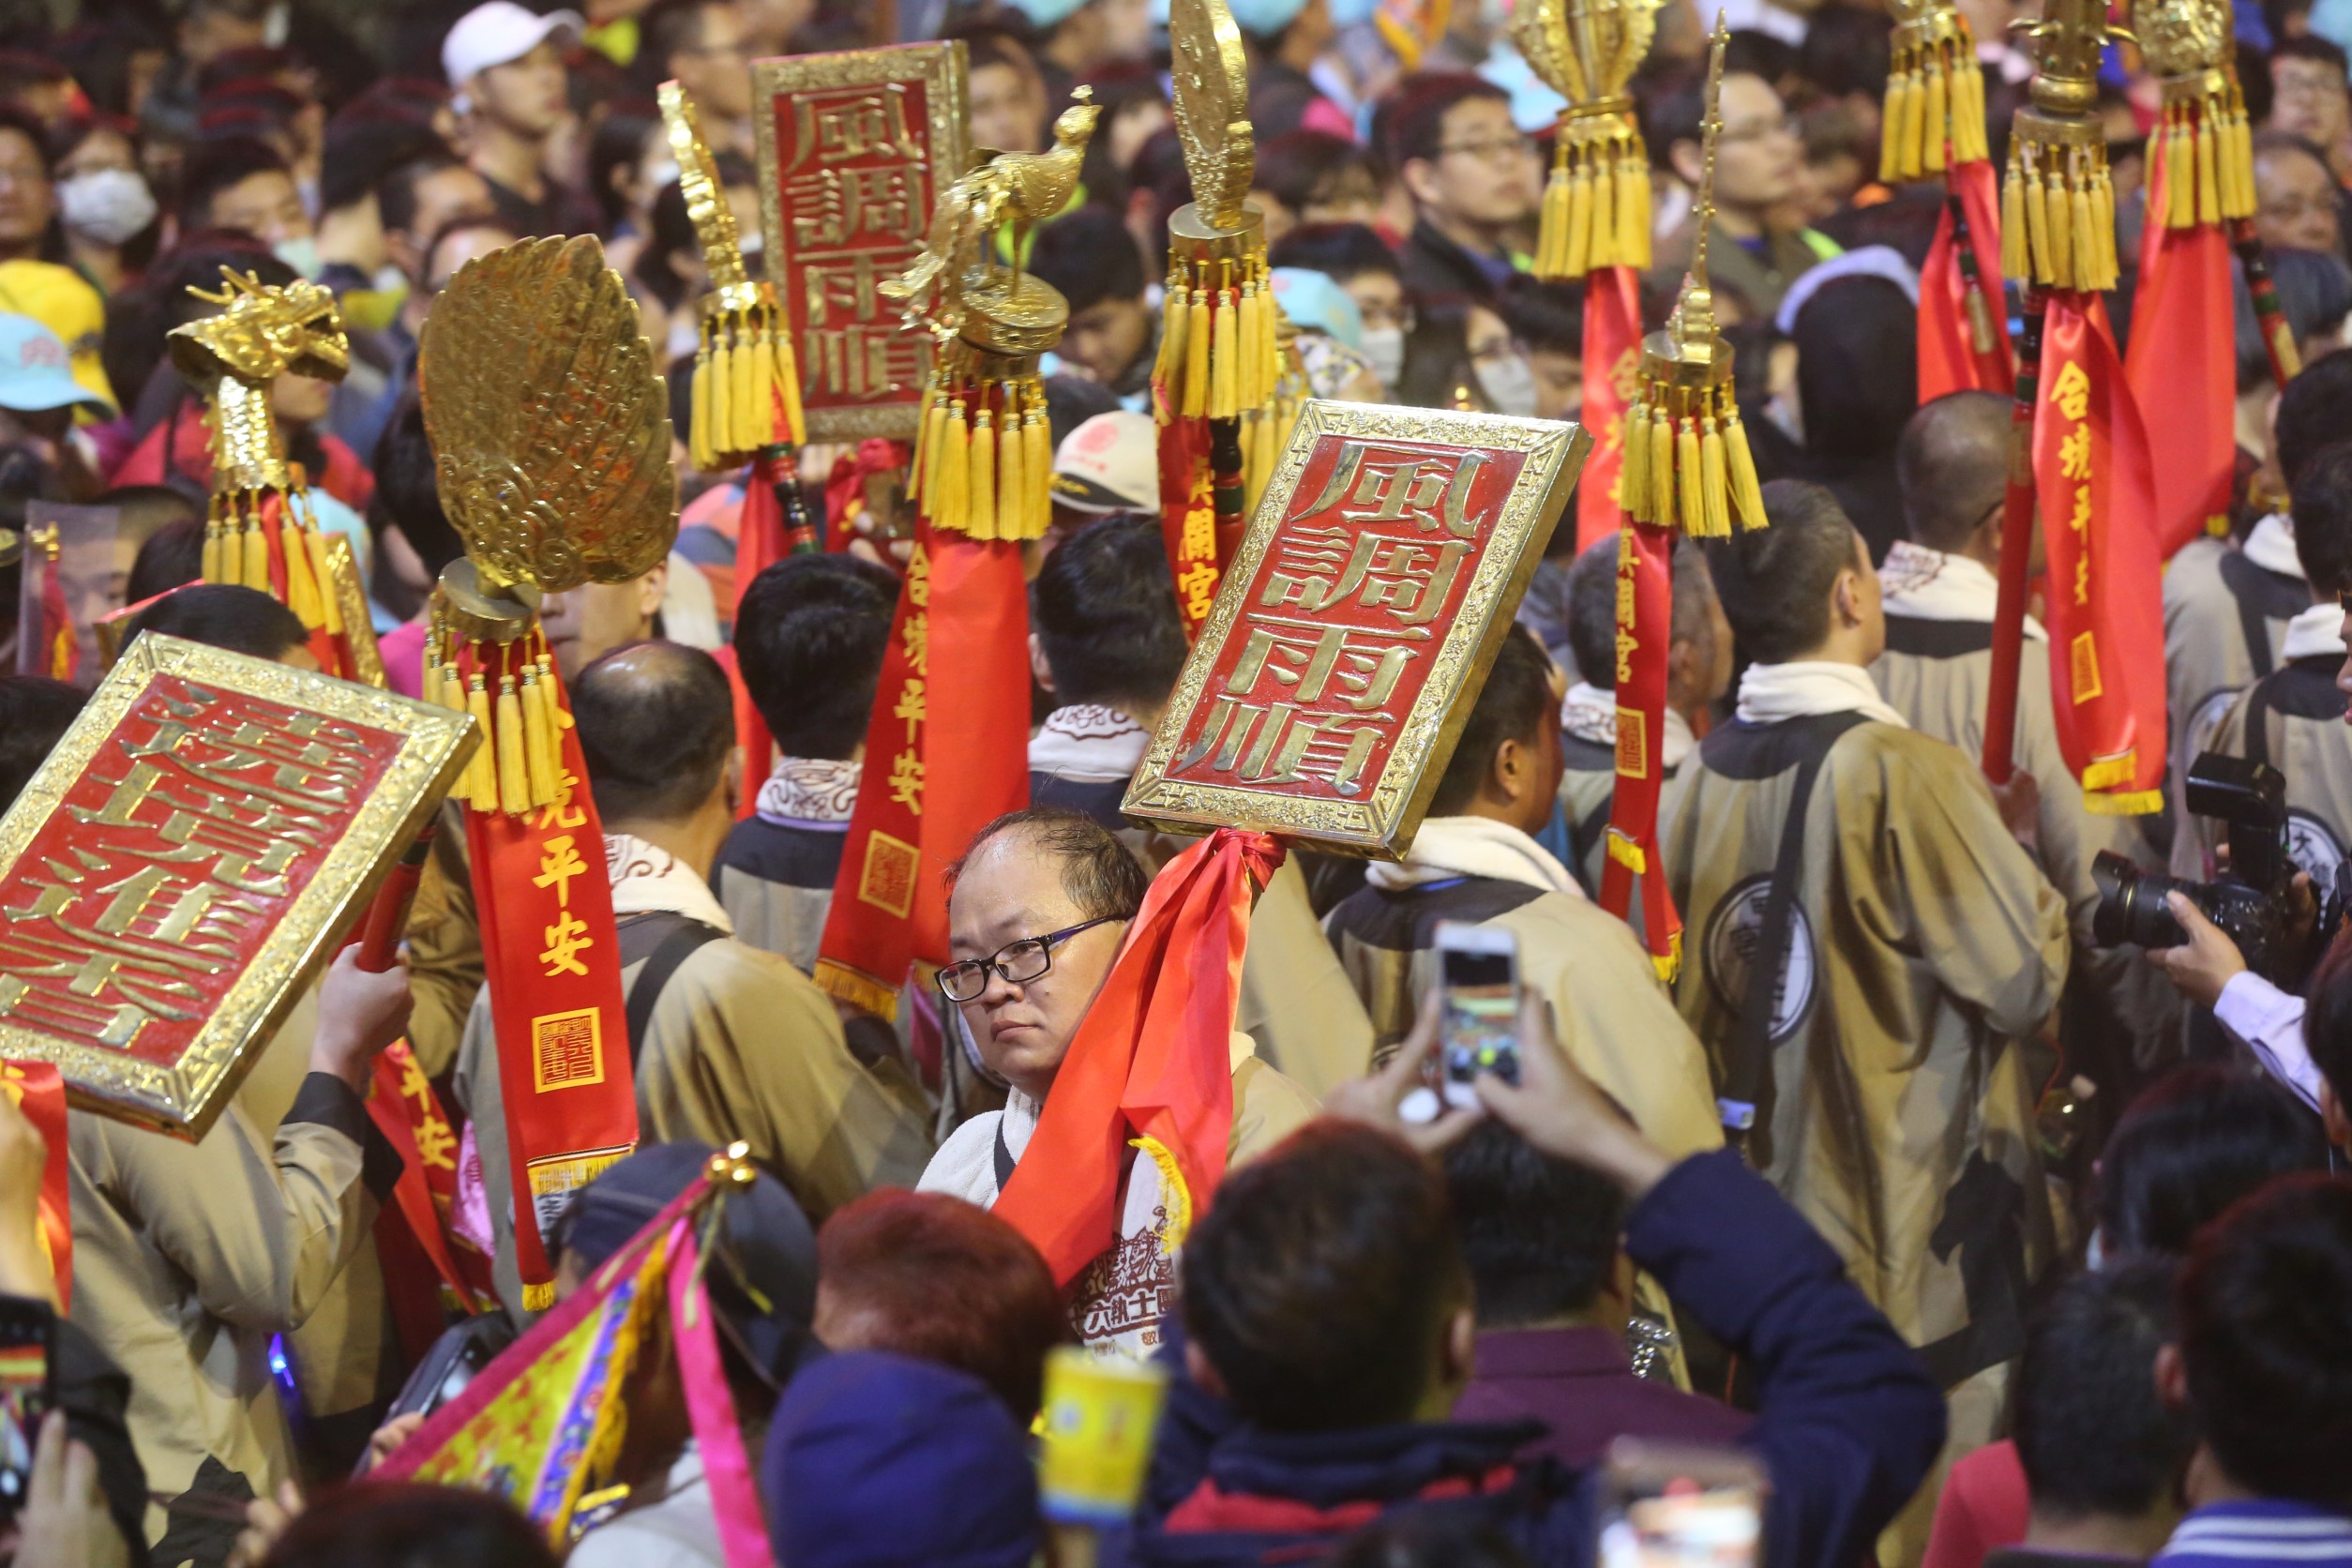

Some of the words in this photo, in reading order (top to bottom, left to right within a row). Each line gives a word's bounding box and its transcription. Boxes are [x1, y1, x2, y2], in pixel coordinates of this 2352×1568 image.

[787, 83, 938, 400] 風調雨順
[888, 542, 929, 816] 合境平安
[1172, 441, 1493, 796] 風調雨順
[0, 682, 374, 1048] 遶境進香
